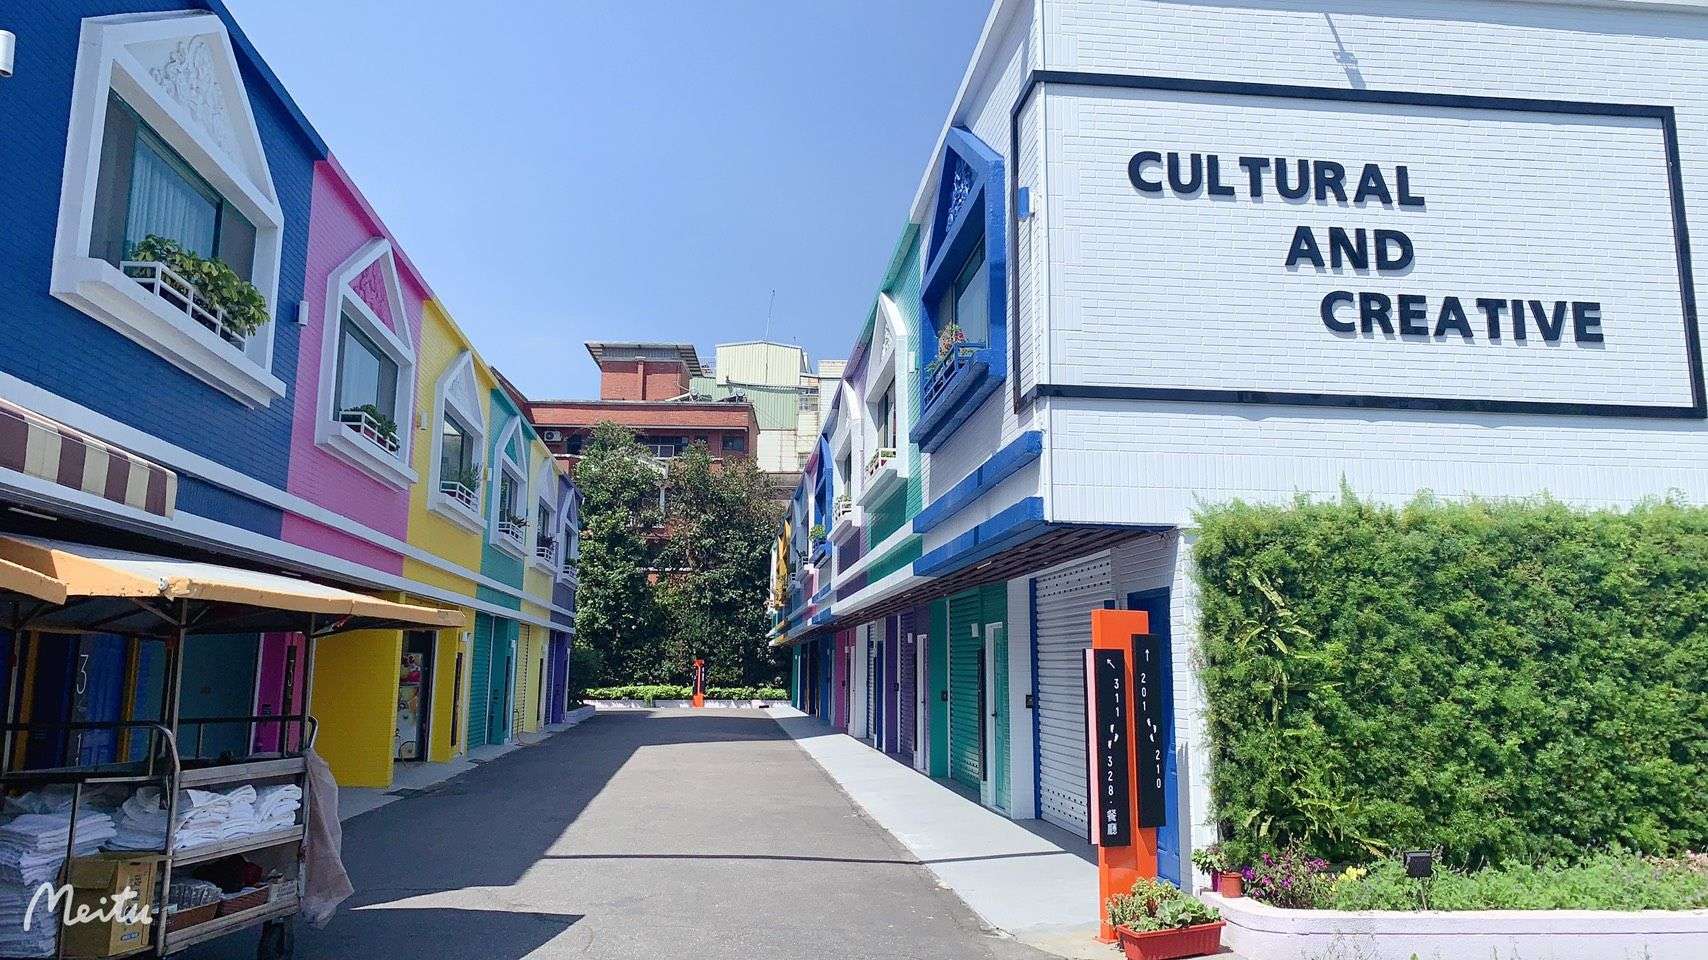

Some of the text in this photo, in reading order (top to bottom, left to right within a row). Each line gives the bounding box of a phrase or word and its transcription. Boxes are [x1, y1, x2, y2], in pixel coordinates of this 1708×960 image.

[1127, 150, 1425, 206] CULTURAL
[1284, 225, 1415, 271] AND
[1319, 290, 1605, 343] CREATIVE
